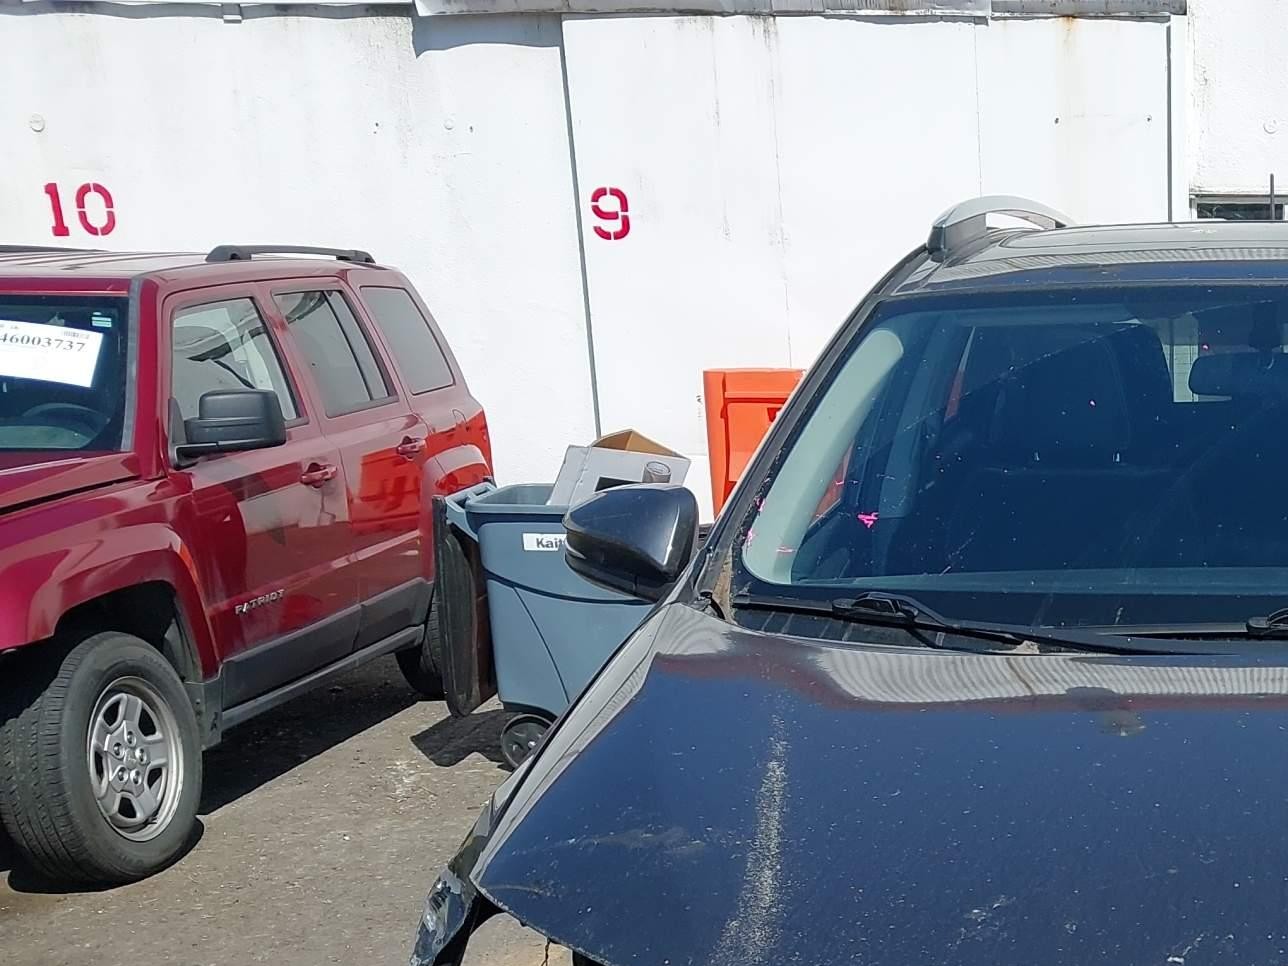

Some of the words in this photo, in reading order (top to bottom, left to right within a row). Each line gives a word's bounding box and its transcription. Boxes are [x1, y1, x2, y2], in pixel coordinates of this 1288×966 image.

[44, 183, 117, 238] 10
[591, 187, 631, 241] 9
[0, 332, 87, 352] 46003737
[235, 589, 285, 615] PATRIOT
